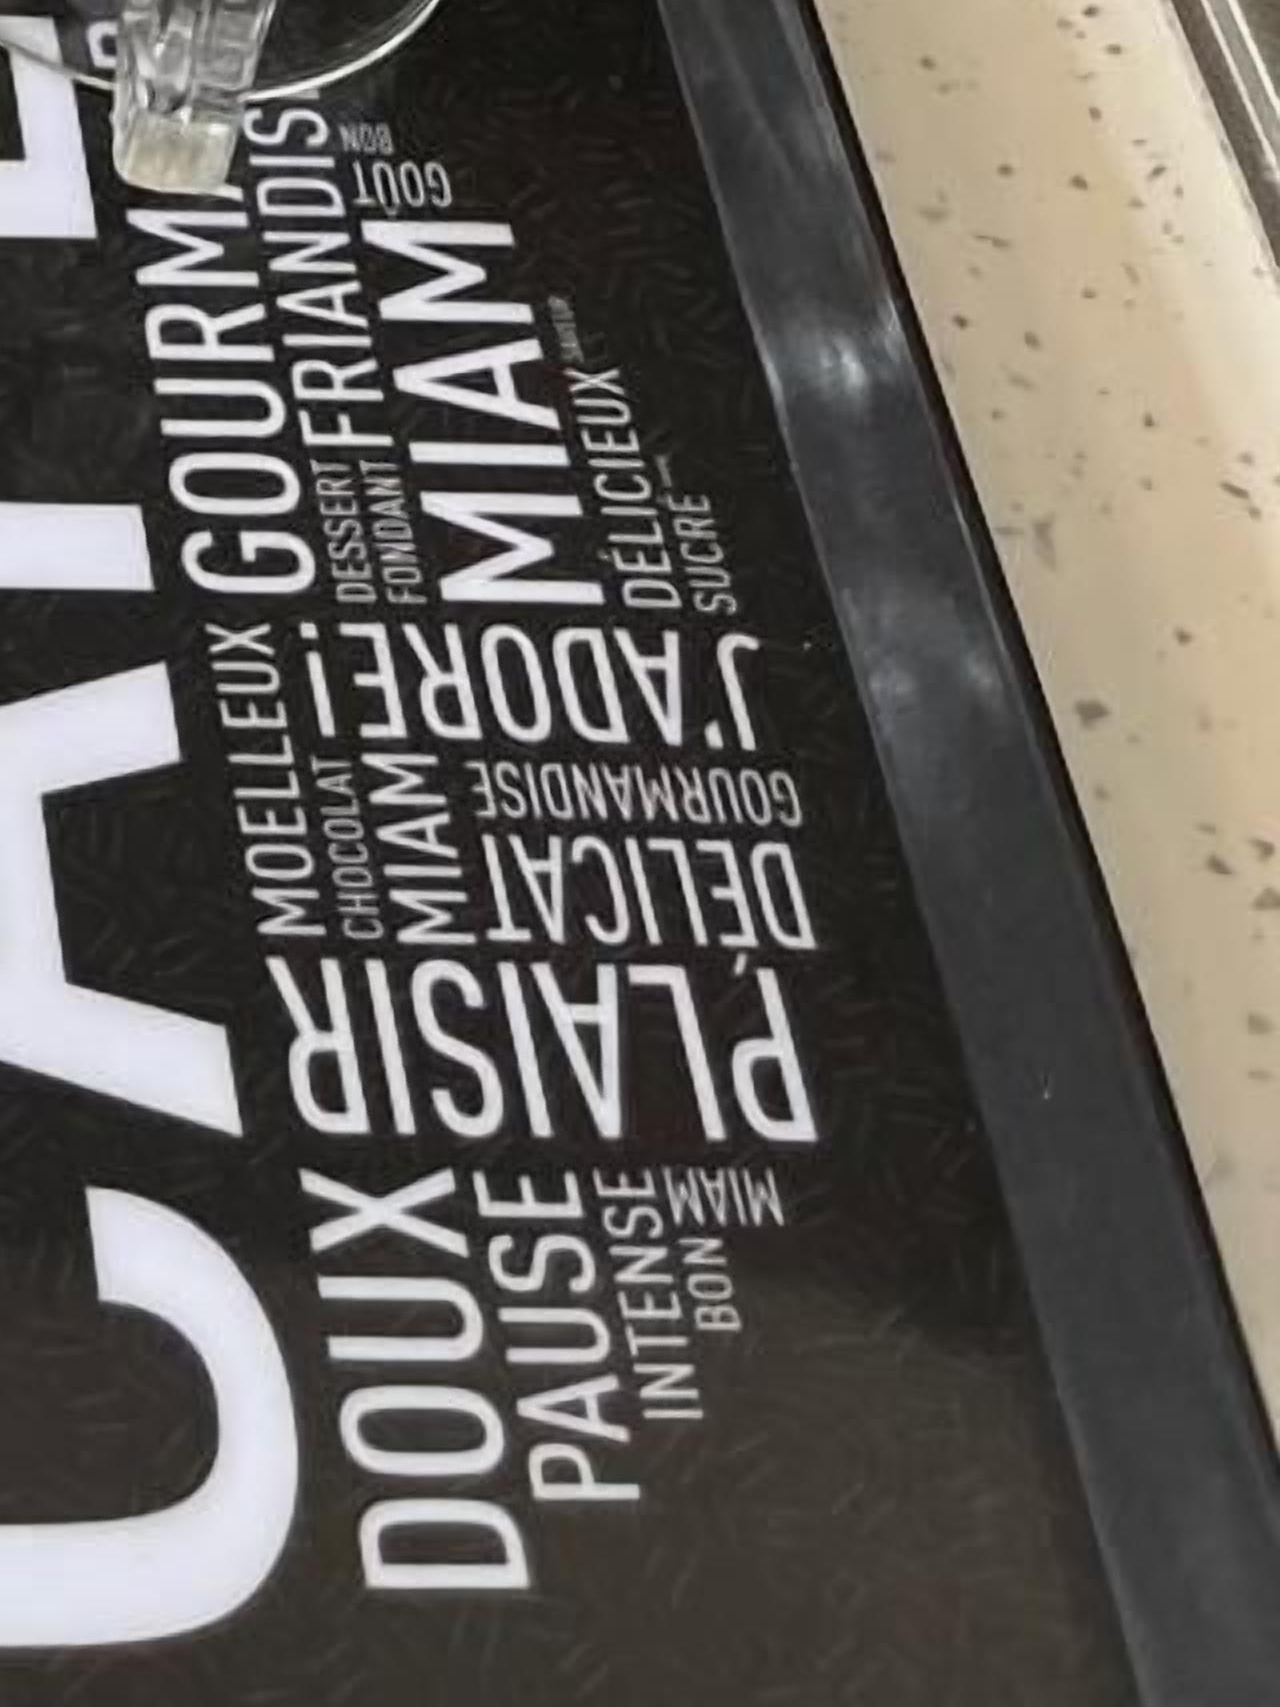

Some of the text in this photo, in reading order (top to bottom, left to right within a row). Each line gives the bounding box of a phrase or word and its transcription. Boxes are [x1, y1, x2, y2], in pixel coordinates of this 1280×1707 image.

[243, 89, 393, 446] FRIANDIS
[361, 220, 605, 605] MIAM
[563, 367, 683, 610] DÉLICIEUX
[312, 459, 378, 604] DESSERT
[360, 460, 427, 605] FONDANT
[205, 623, 326, 935] MOELLEUX
[299, 622, 759, 751] J'ADORE!
[311, 755, 384, 939] CHOCOLAT
[361, 752, 477, 944] MIAM
[464, 760, 803, 827] GOURMANDISE
[482, 834, 818, 975] DÉLICAT
[265, 957, 818, 1142] PLAISIR
[662, 1166, 785, 1226] MIAM
[679, 1237, 741, 1331] BON
[299, 1167, 530, 1589] DOUX
[473, 1171, 640, 1500] PAUSE
[594, 1167, 703, 1419] INTENSE
